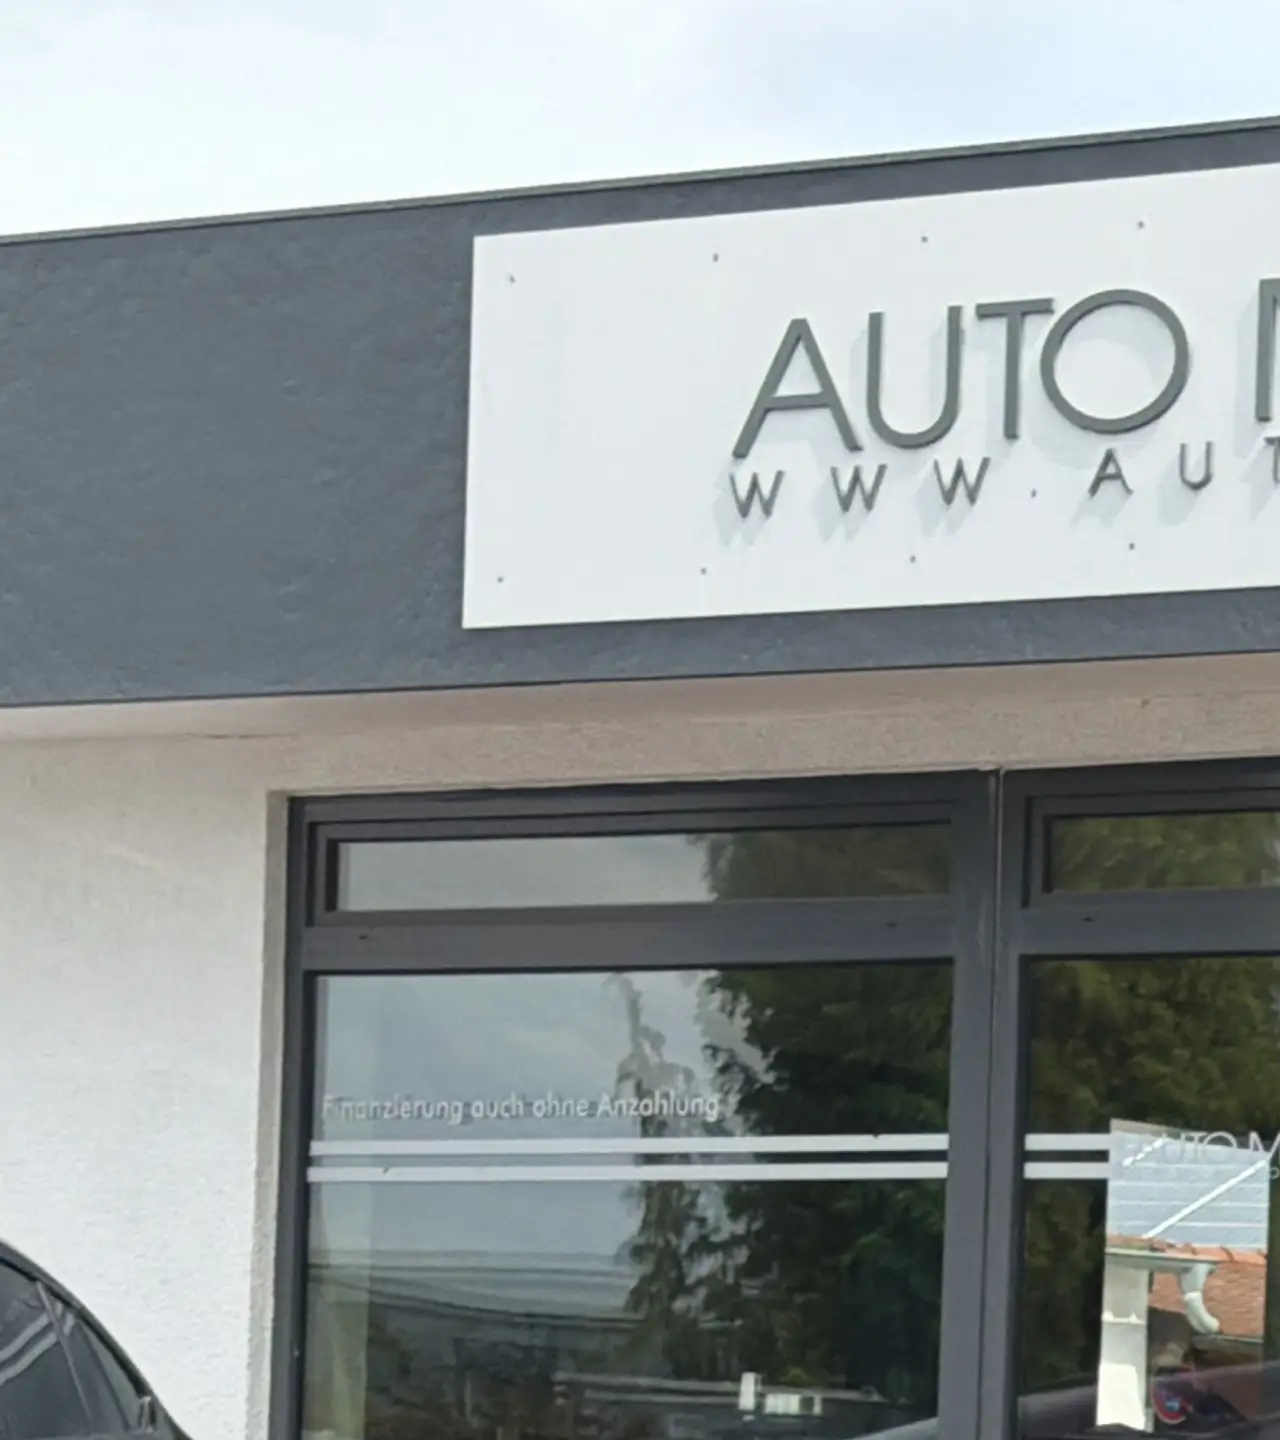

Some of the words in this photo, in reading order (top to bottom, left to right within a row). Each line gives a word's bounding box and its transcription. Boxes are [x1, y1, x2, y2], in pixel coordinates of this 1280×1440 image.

[732, 289, 1190, 459] AUTO
[322, 1092, 463, 1125] Finanzierung
[470, 1092, 524, 1118] auch
[531, 1090, 589, 1118] ohne
[596, 1089, 720, 1122] Anzahlung
